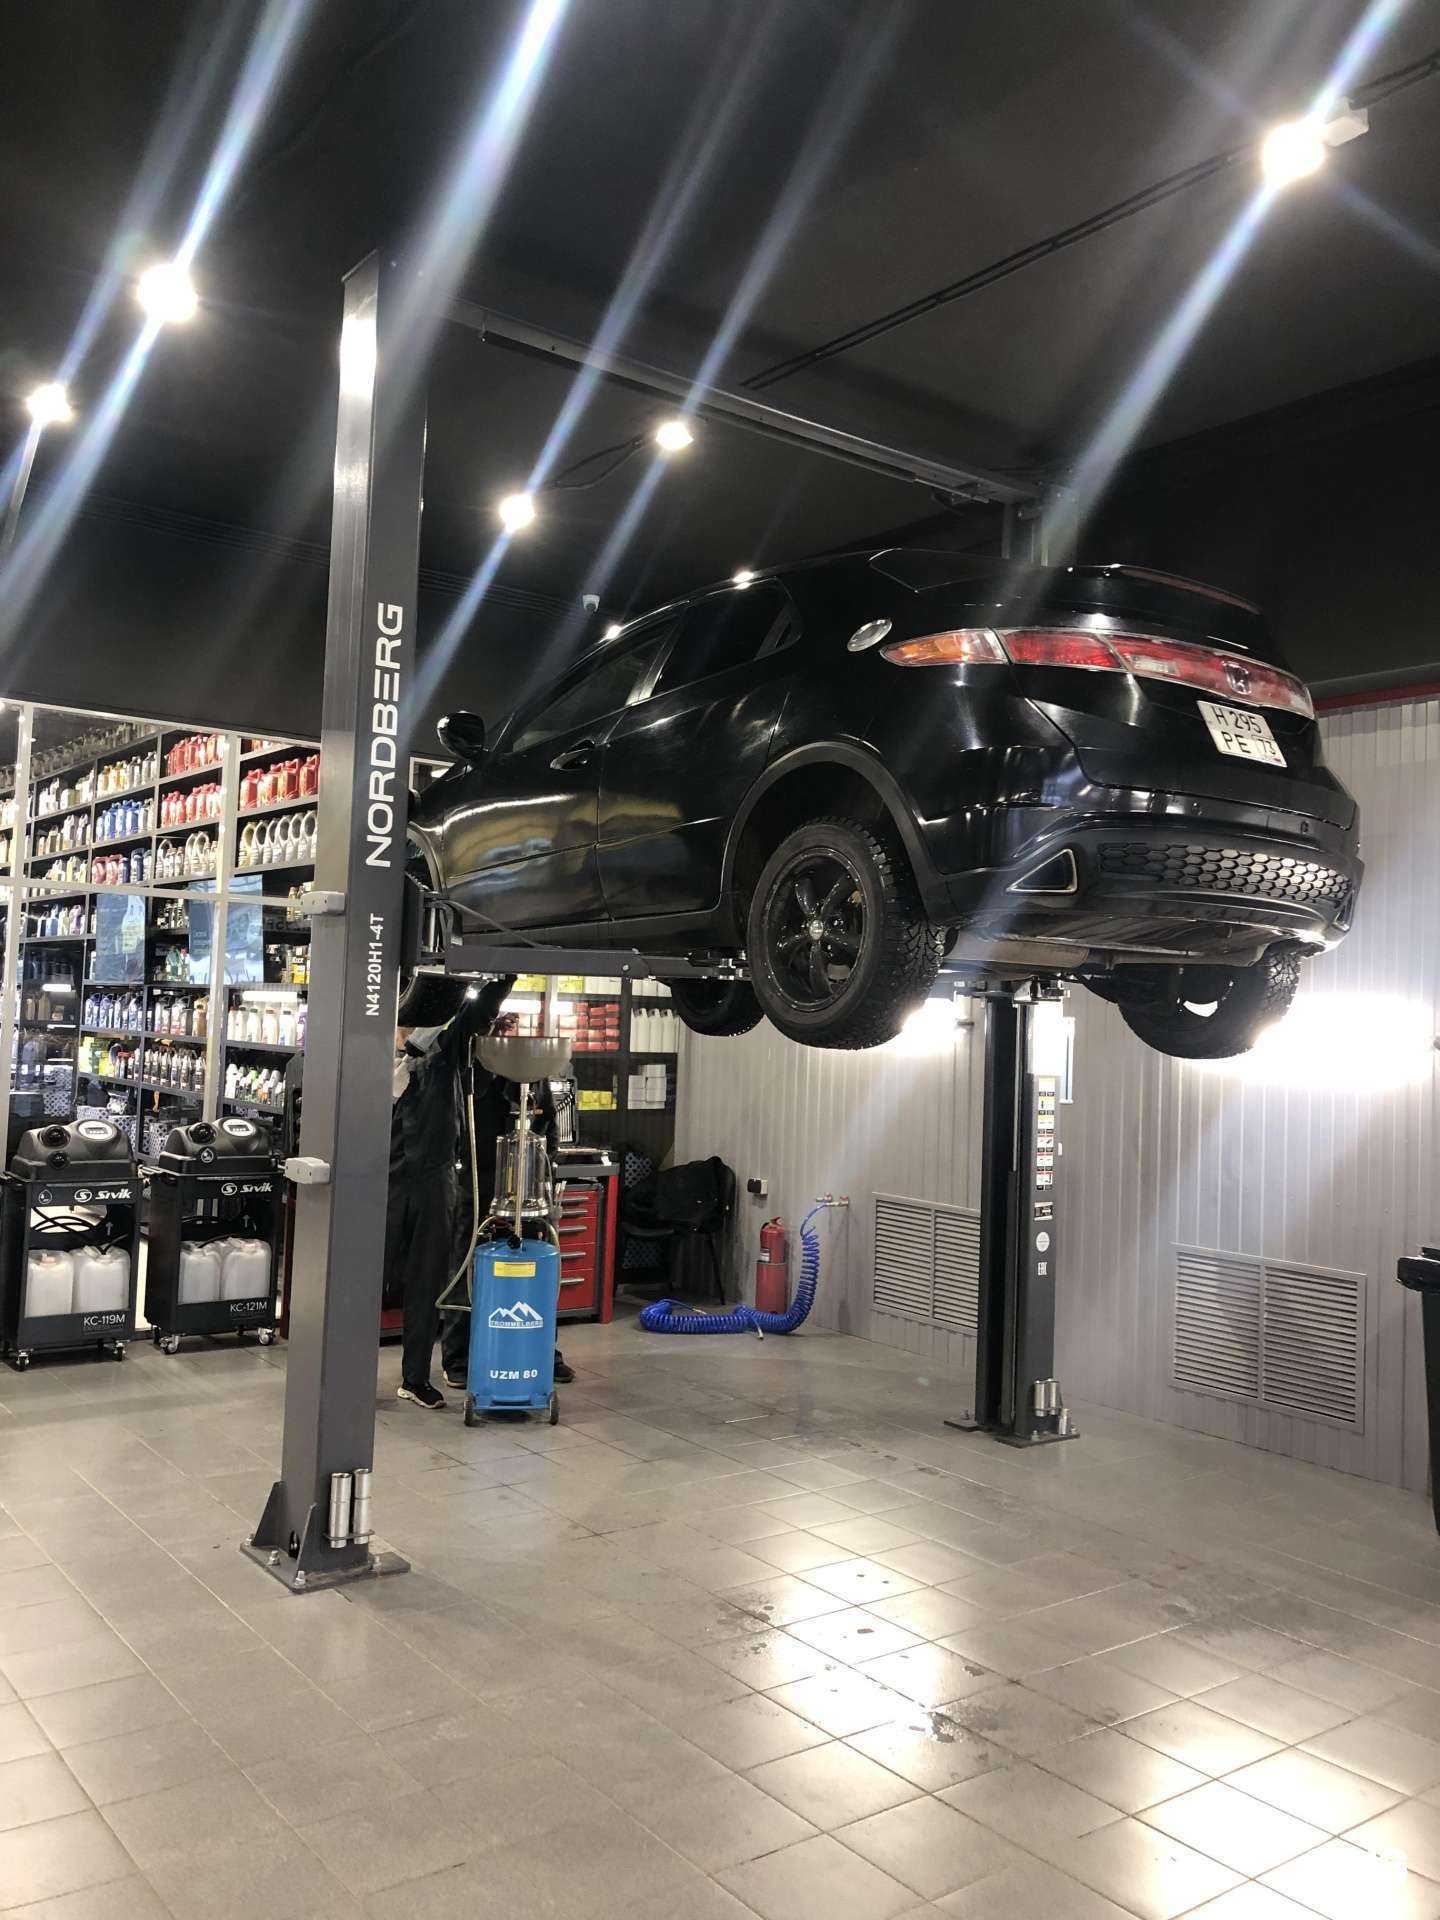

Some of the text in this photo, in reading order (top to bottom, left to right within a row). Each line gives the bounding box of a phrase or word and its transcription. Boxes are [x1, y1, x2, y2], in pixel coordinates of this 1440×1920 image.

[365, 602, 403, 868] NORDBERG
[1229, 711, 1262, 733] 295
[365, 913, 384, 1016] N4120H1-4T
[489, 1369, 538, 1380] UZM 80
